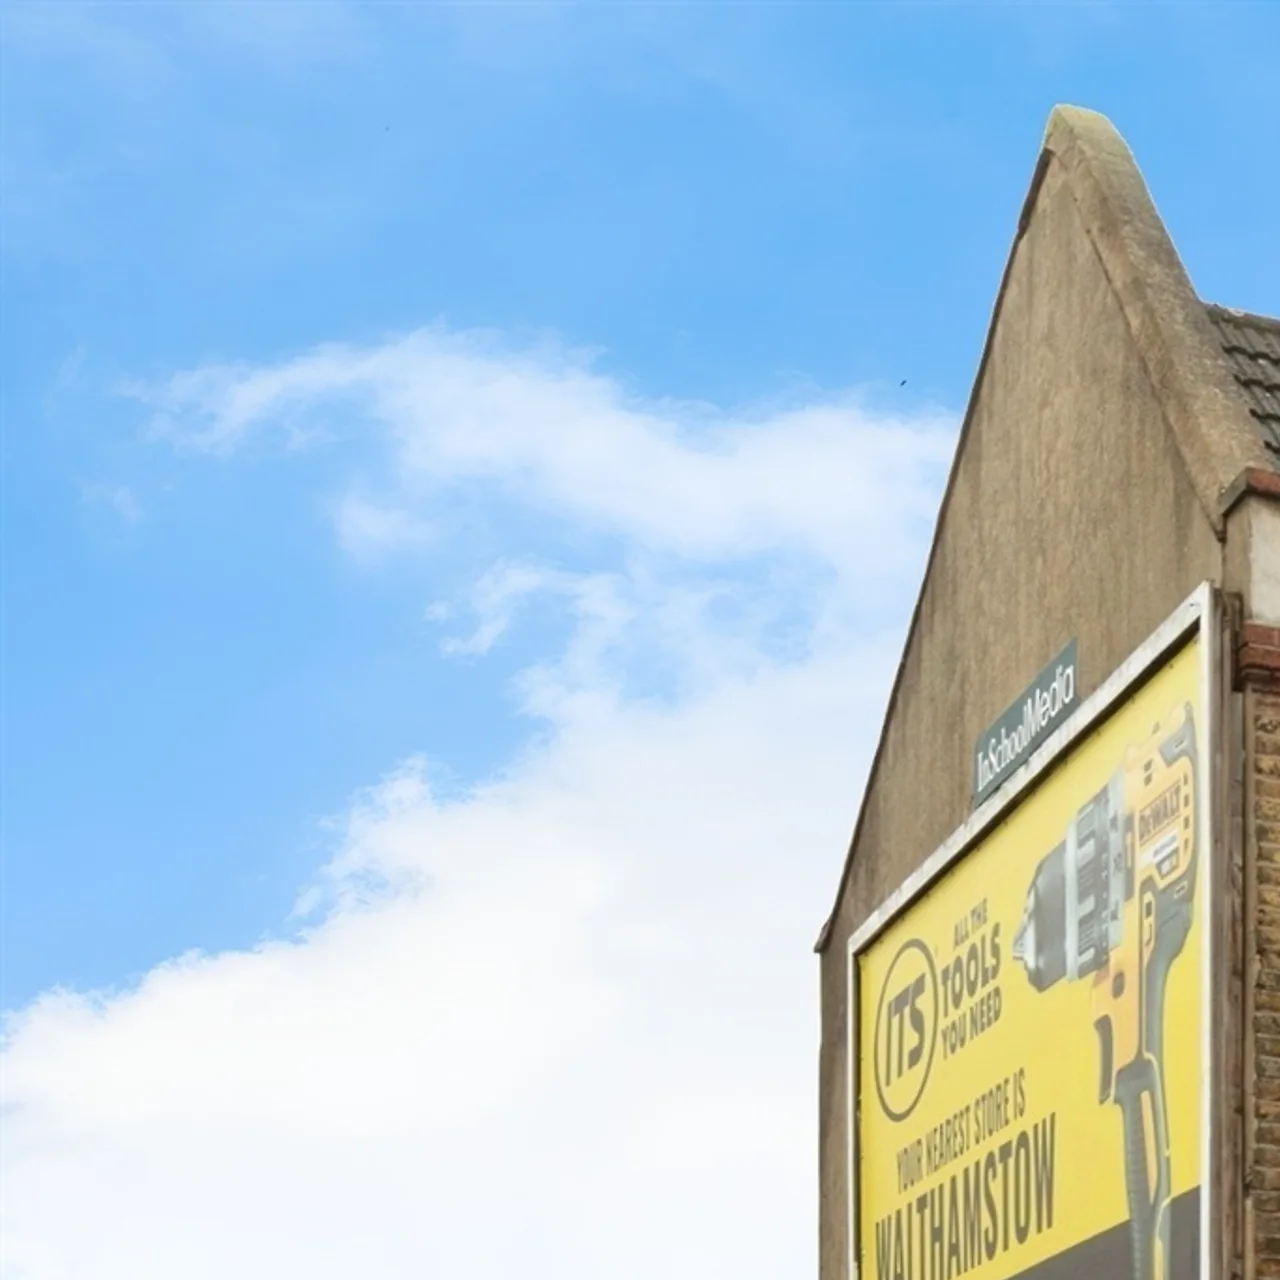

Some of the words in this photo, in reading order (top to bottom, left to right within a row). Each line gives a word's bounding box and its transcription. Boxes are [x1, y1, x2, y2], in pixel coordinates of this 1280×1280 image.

[976, 663, 1076, 793] InSchoolMedia
[940, 921, 1001, 1018] TOOLS
[953, 914, 970, 949] ALL
[970, 897, 988, 935] THE
[884, 972, 926, 1088] ITS
[940, 1010, 967, 1062] YOU
[968, 985, 1002, 1041] NEED
[896, 1137, 924, 1195] YOUR
[925, 1103, 971, 1177] NEAREST
[973, 1076, 1010, 1146] STORE
[1012, 1066, 1026, 1121] IS
